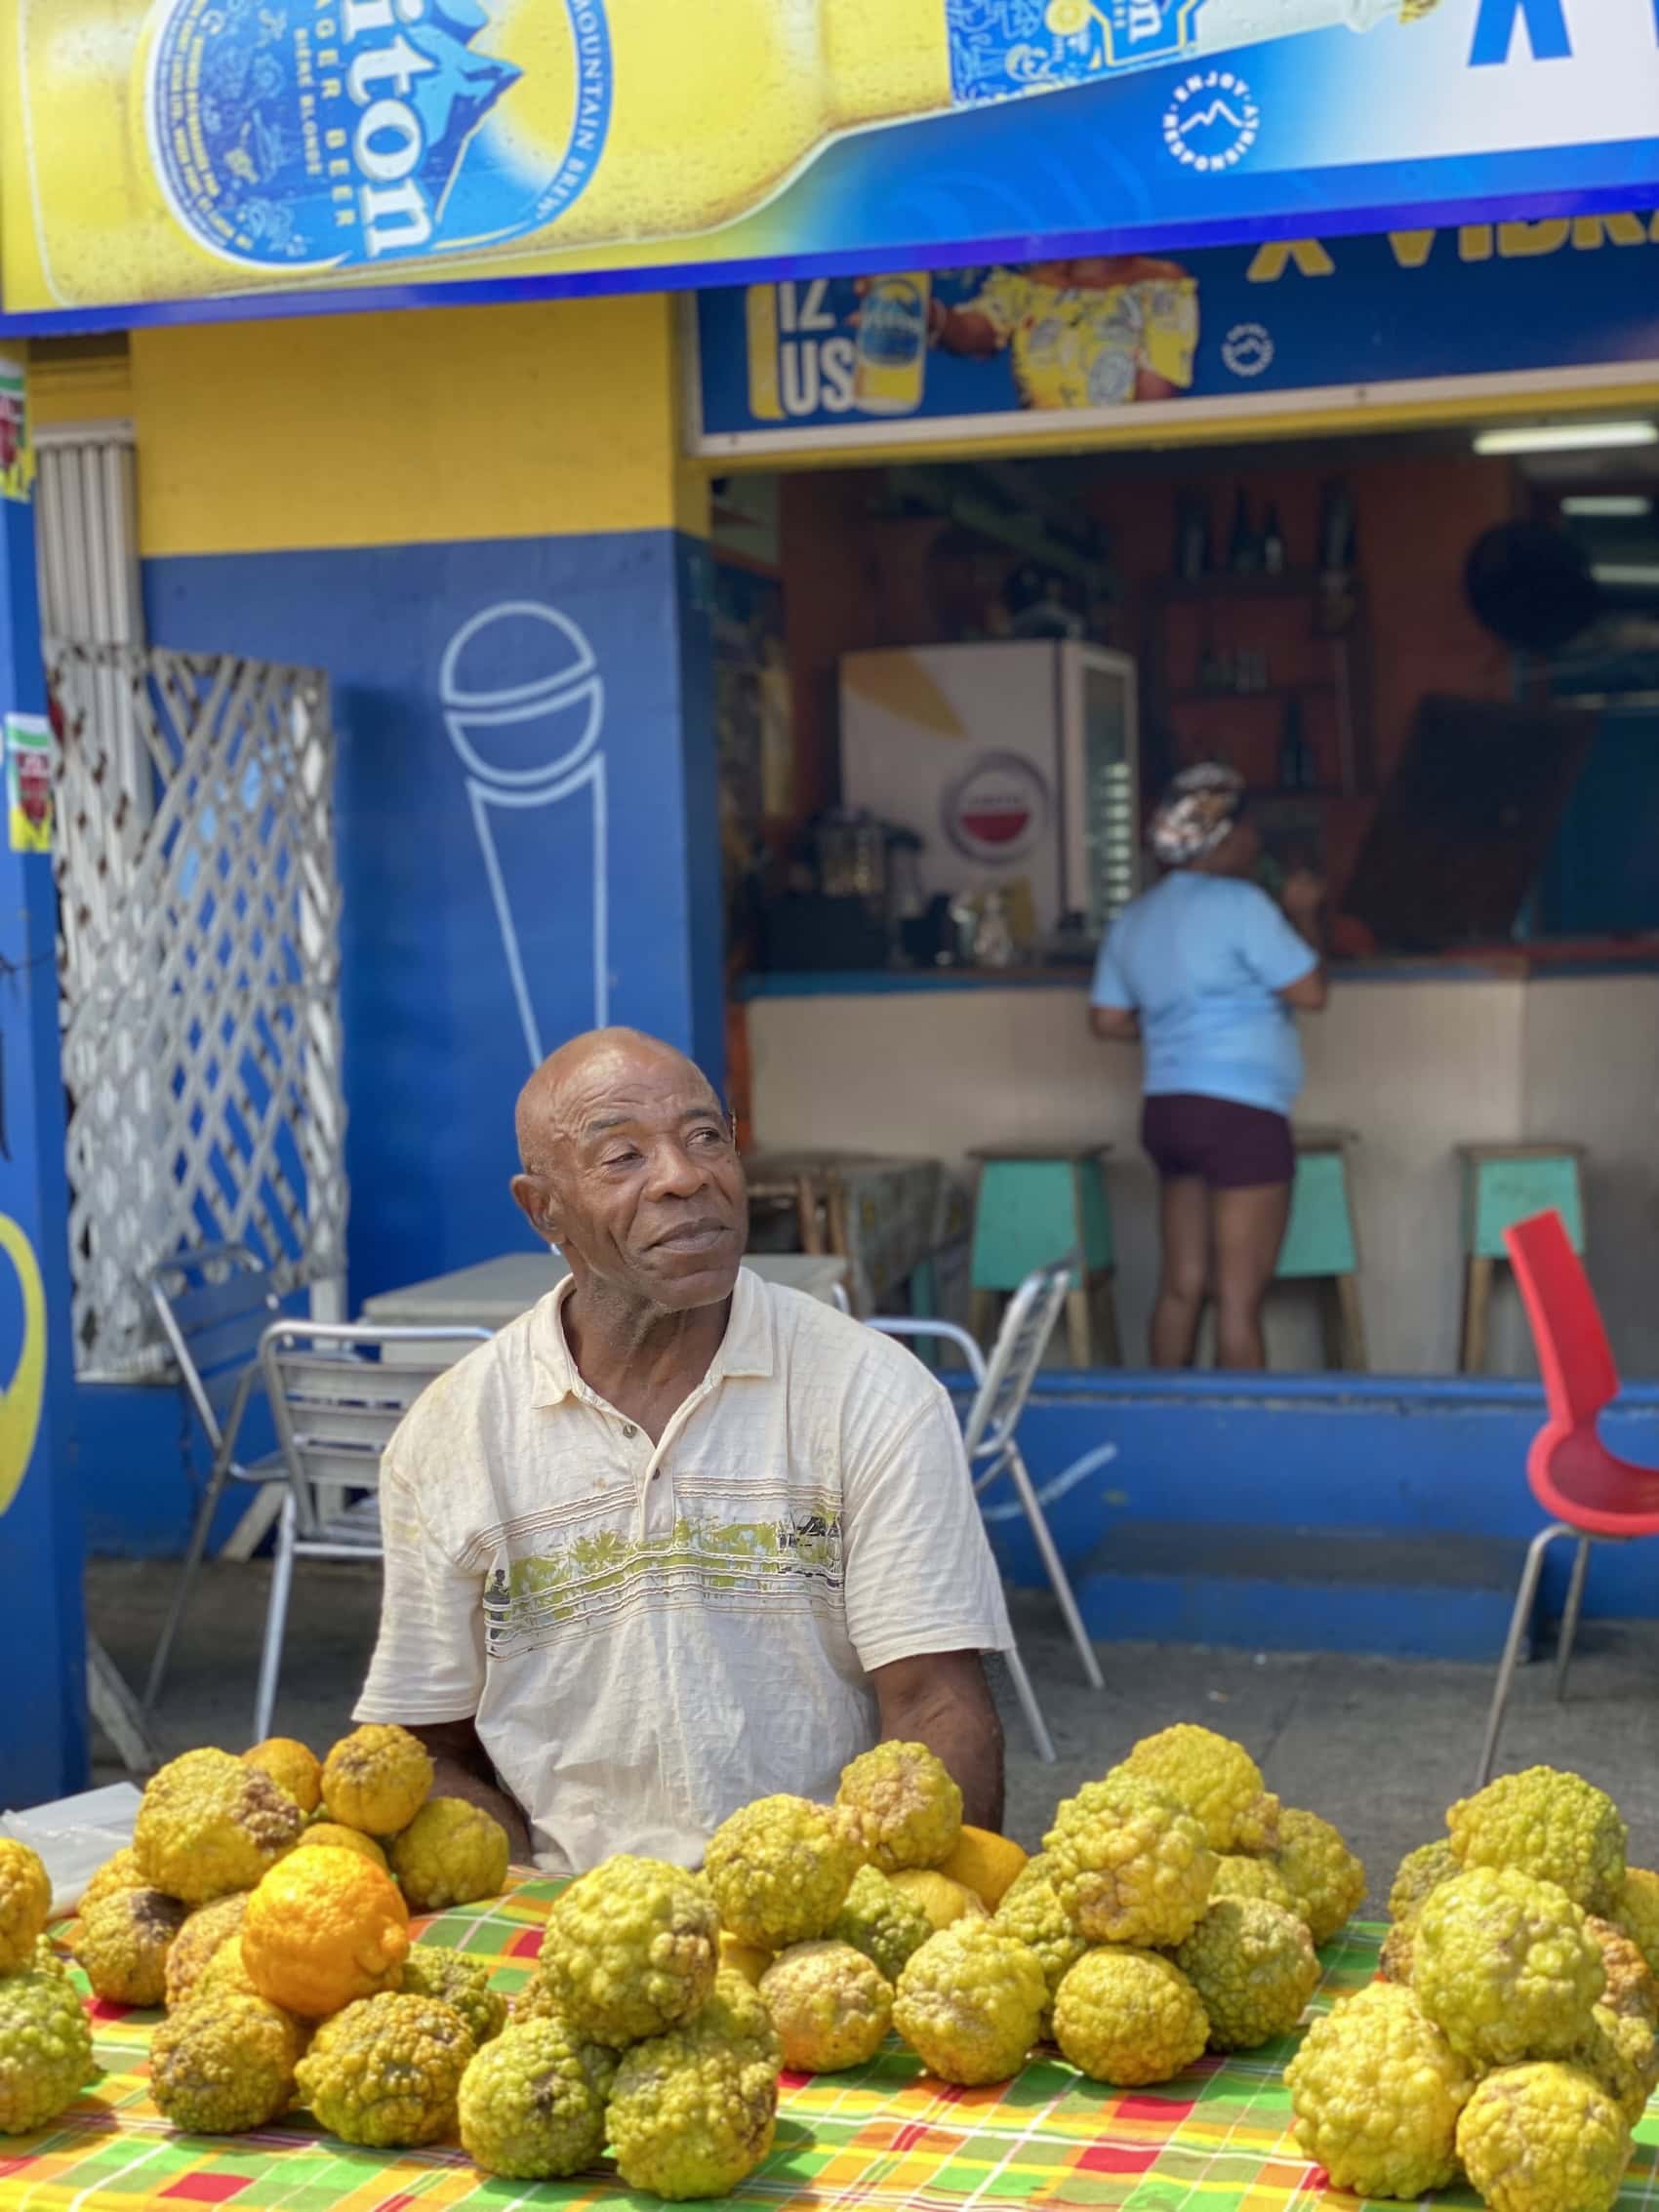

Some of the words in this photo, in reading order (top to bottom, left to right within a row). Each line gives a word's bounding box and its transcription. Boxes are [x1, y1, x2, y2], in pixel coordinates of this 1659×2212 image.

[299, 95, 323, 177] BLONDE
[342, 0, 441, 257] iton
[325, 129, 356, 227] BEER
[781, 337, 856, 417] US
